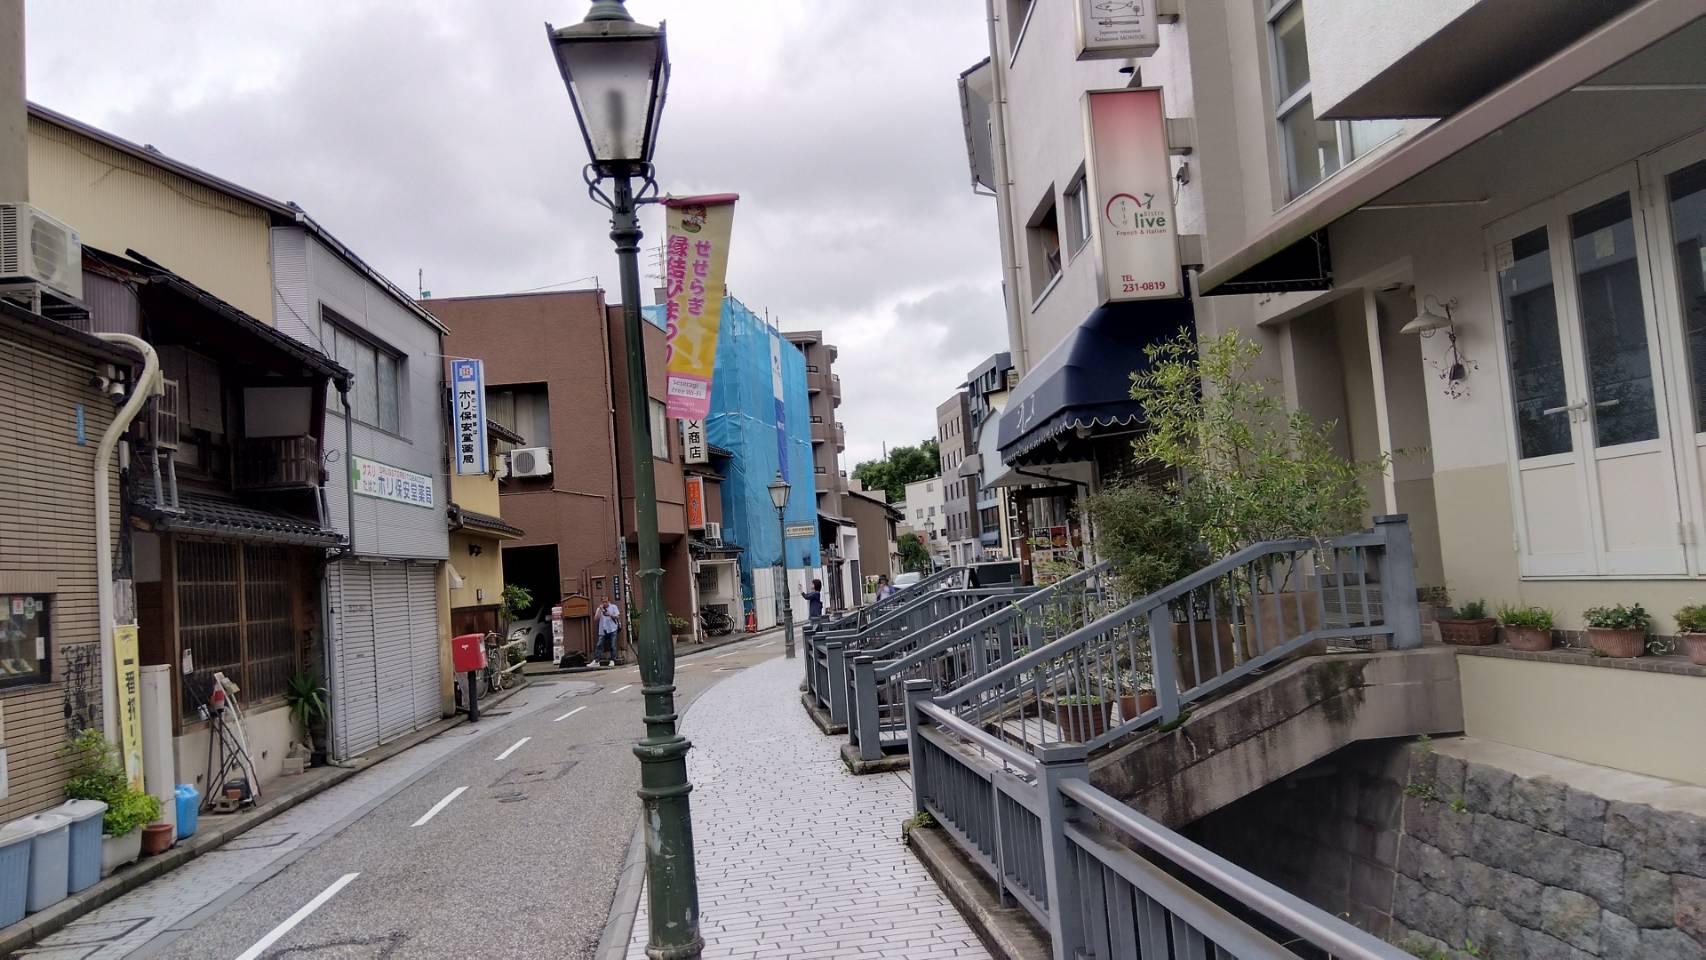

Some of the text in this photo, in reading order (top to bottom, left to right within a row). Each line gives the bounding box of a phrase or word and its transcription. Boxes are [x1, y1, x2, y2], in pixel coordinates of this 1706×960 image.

[1146, 227, 1167, 235] Italian
[687, 240, 712, 316] せせらぎ
[1121, 274, 1135, 283] TEL
[1123, 281, 1166, 293] 231-0819
[459, 390, 475, 465] ホリ保安堂薬局
[362, 463, 376, 478] クスリ
[378, 475, 432, 505] ホリ保安堂薬局
